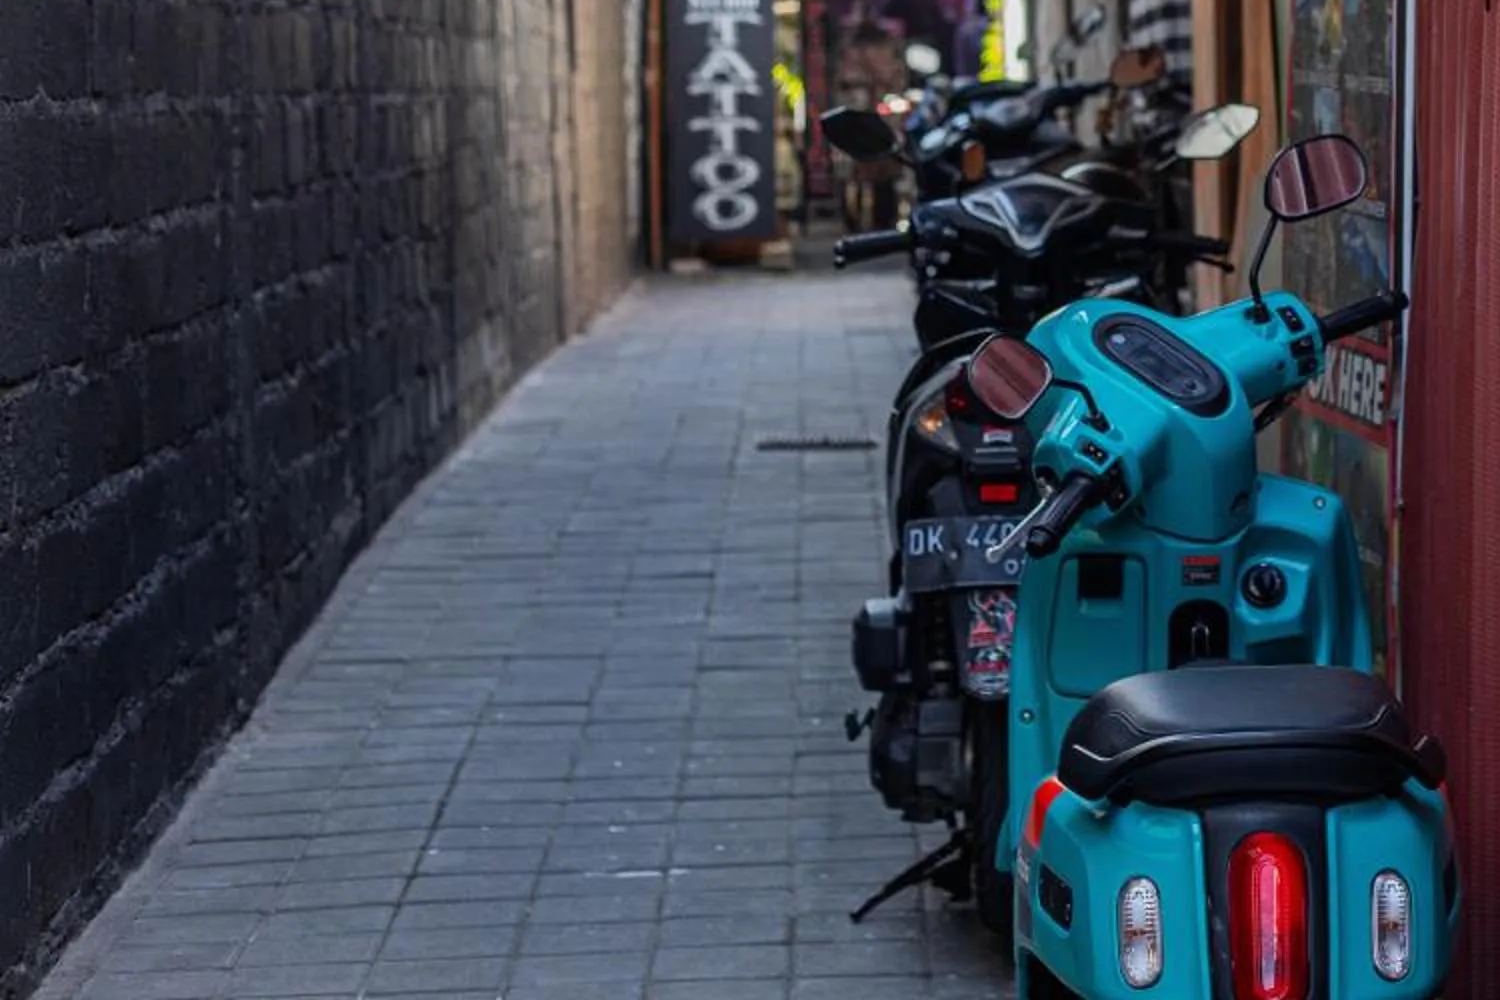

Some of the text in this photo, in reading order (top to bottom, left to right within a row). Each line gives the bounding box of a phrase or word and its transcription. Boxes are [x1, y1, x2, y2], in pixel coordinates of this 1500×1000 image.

[685, 11, 763, 230] TATTOO
[1339, 350, 1387, 424] HERE
[909, 525, 944, 555] DK
